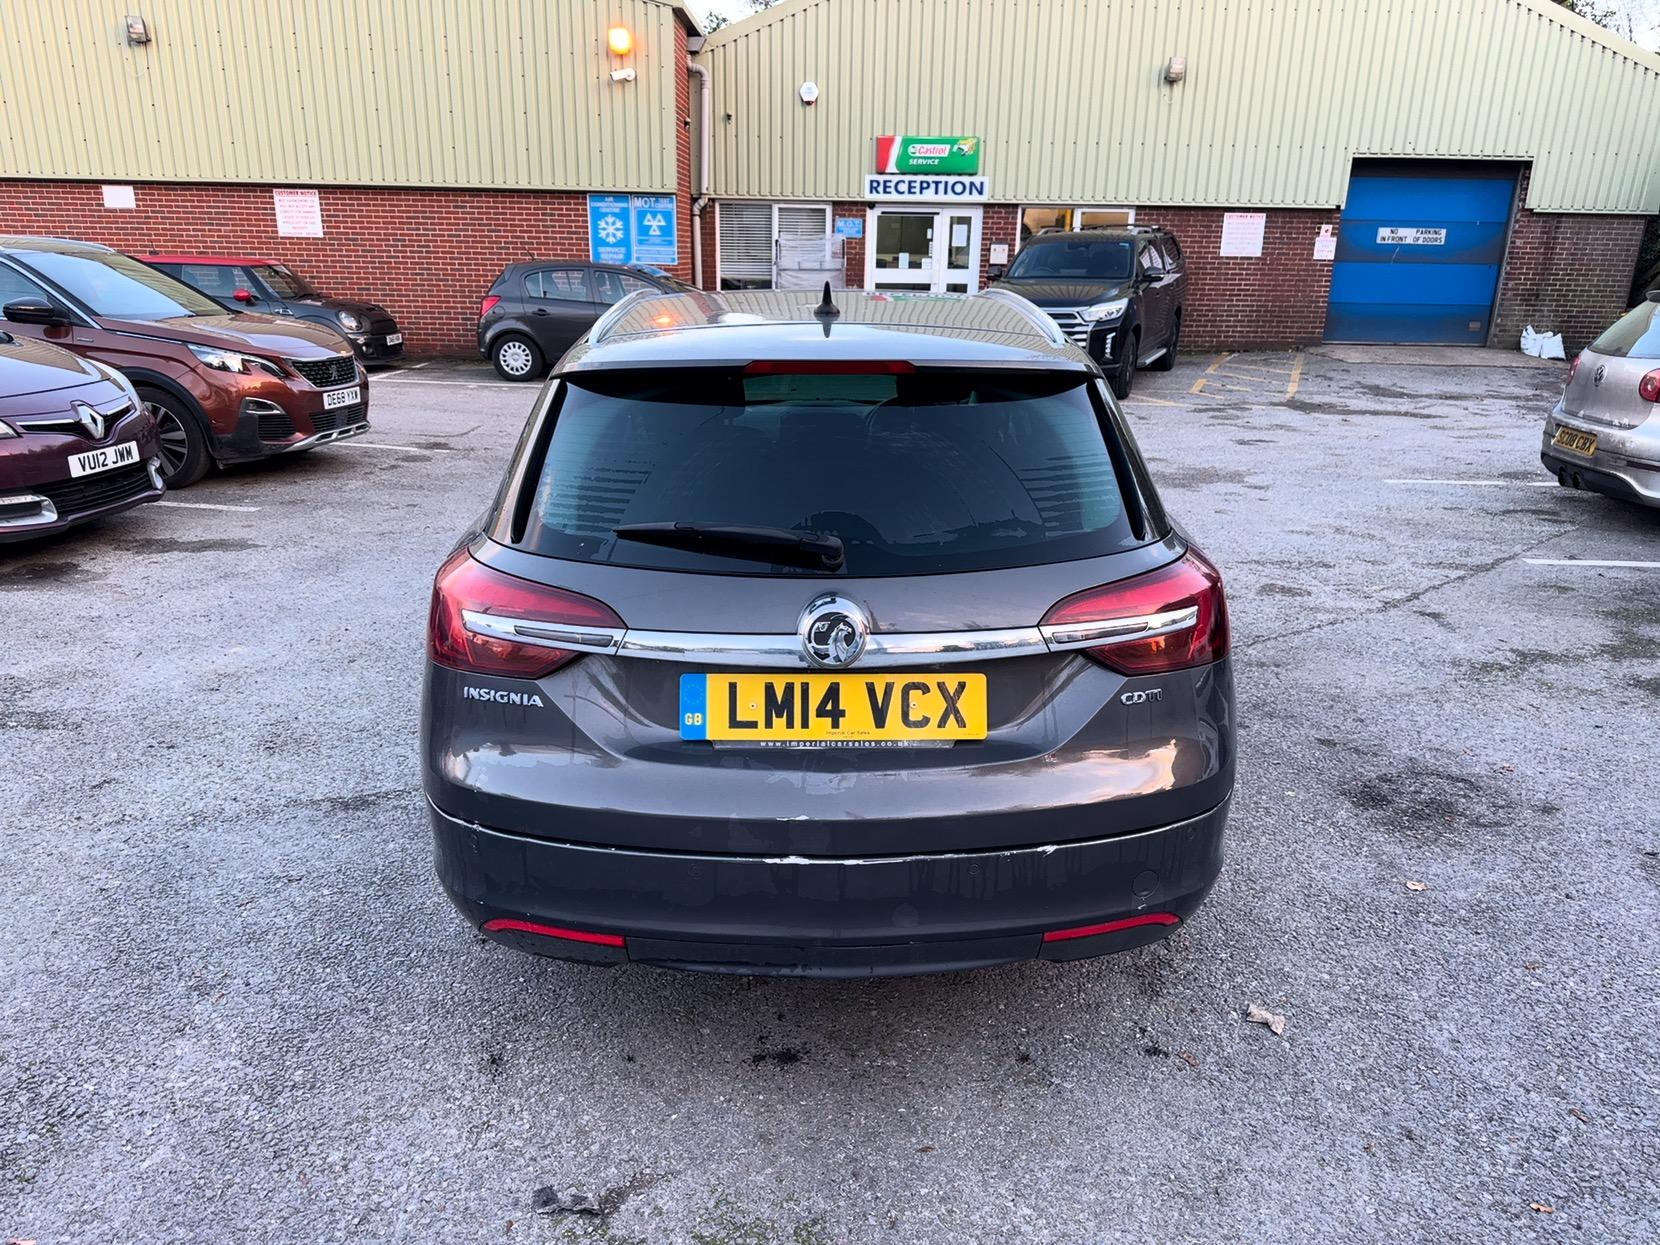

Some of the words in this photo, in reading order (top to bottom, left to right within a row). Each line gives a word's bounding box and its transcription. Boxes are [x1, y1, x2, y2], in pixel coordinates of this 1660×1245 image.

[917, 145, 947, 155] Castrol
[869, 179, 984, 196] RECEPTION
[634, 197, 656, 208] MOT
[327, 391, 346, 406] DE68
[77, 451, 109, 472] VU12
[112, 444, 134, 465] JWM
[463, 686, 544, 708] INSIGNIA
[684, 713, 704, 726] GB
[728, 681, 847, 730] LM14
[865, 681, 967, 729] VCX
[760, 740, 909, 748] www.imperialcarsales.co.uk
